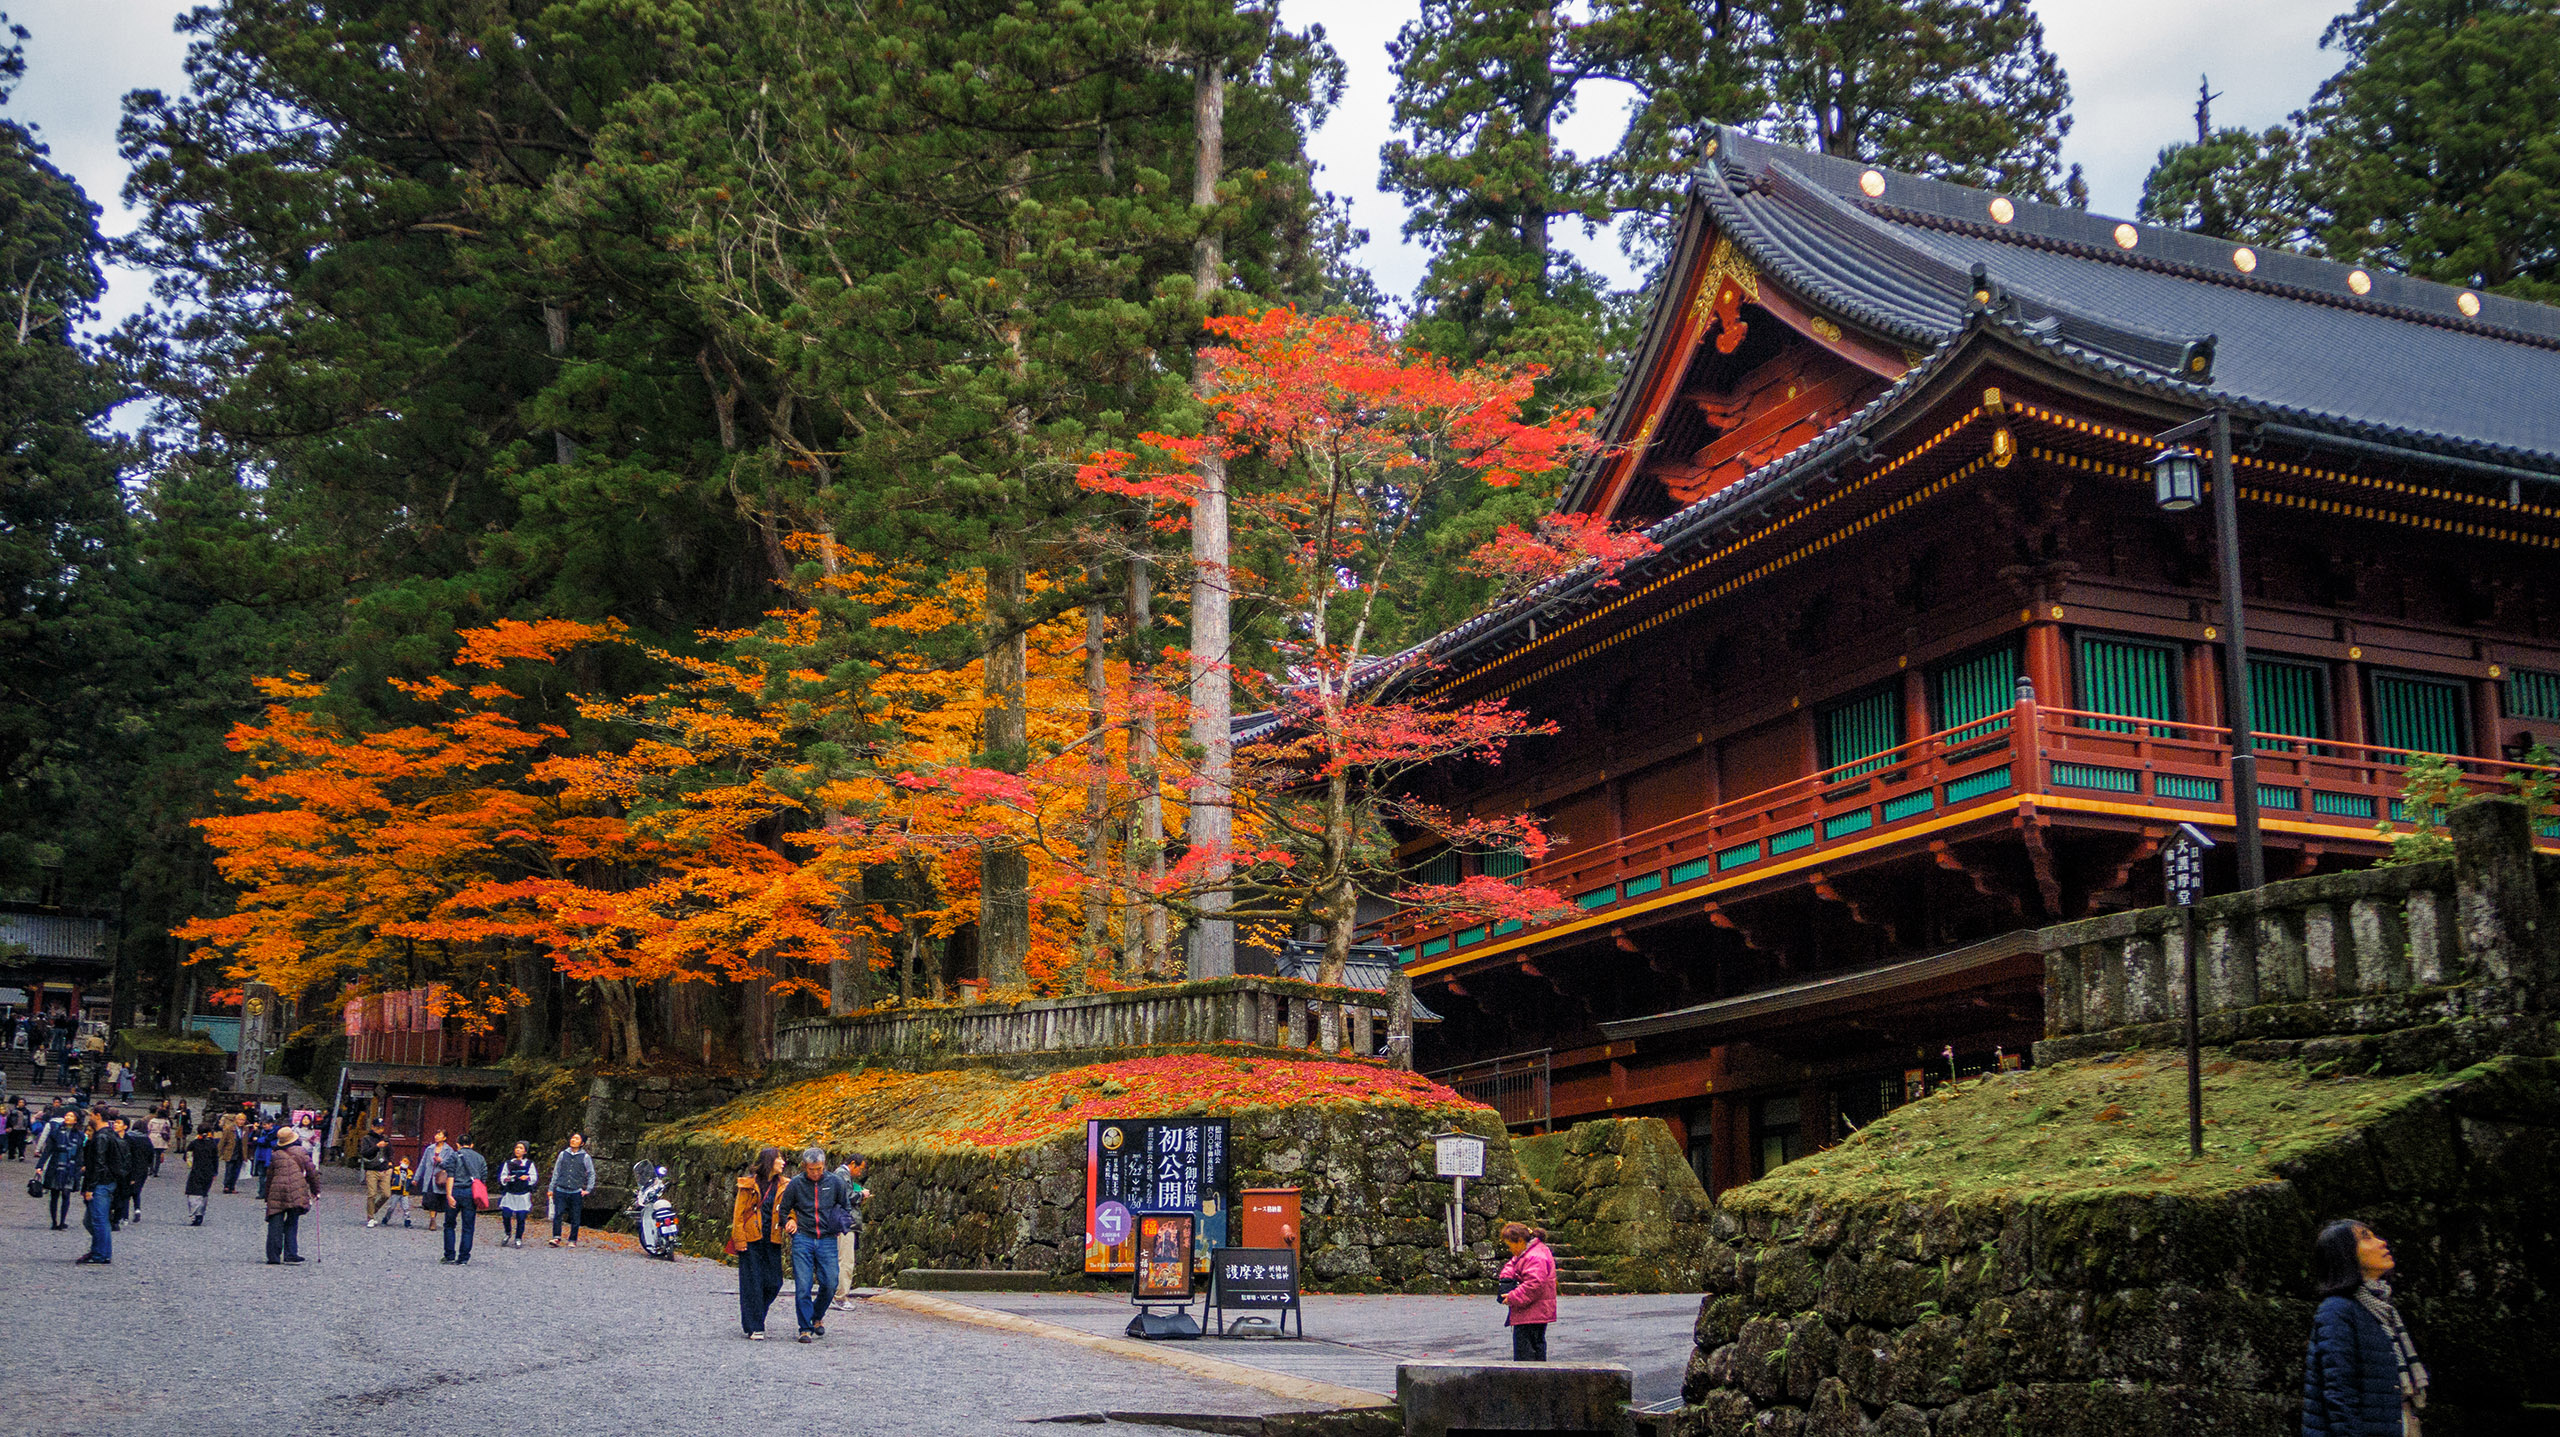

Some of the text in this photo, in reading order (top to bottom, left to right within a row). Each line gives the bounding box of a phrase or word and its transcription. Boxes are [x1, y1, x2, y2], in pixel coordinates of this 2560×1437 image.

[2176, 839, 2191, 905] 大護摩堂
[1158, 1125, 1183, 1209] 初公開
[1144, 1219, 1157, 1236] 福
[1140, 1248, 1149, 1279] 七福神
[1225, 1264, 1265, 1280] 護摩堂
